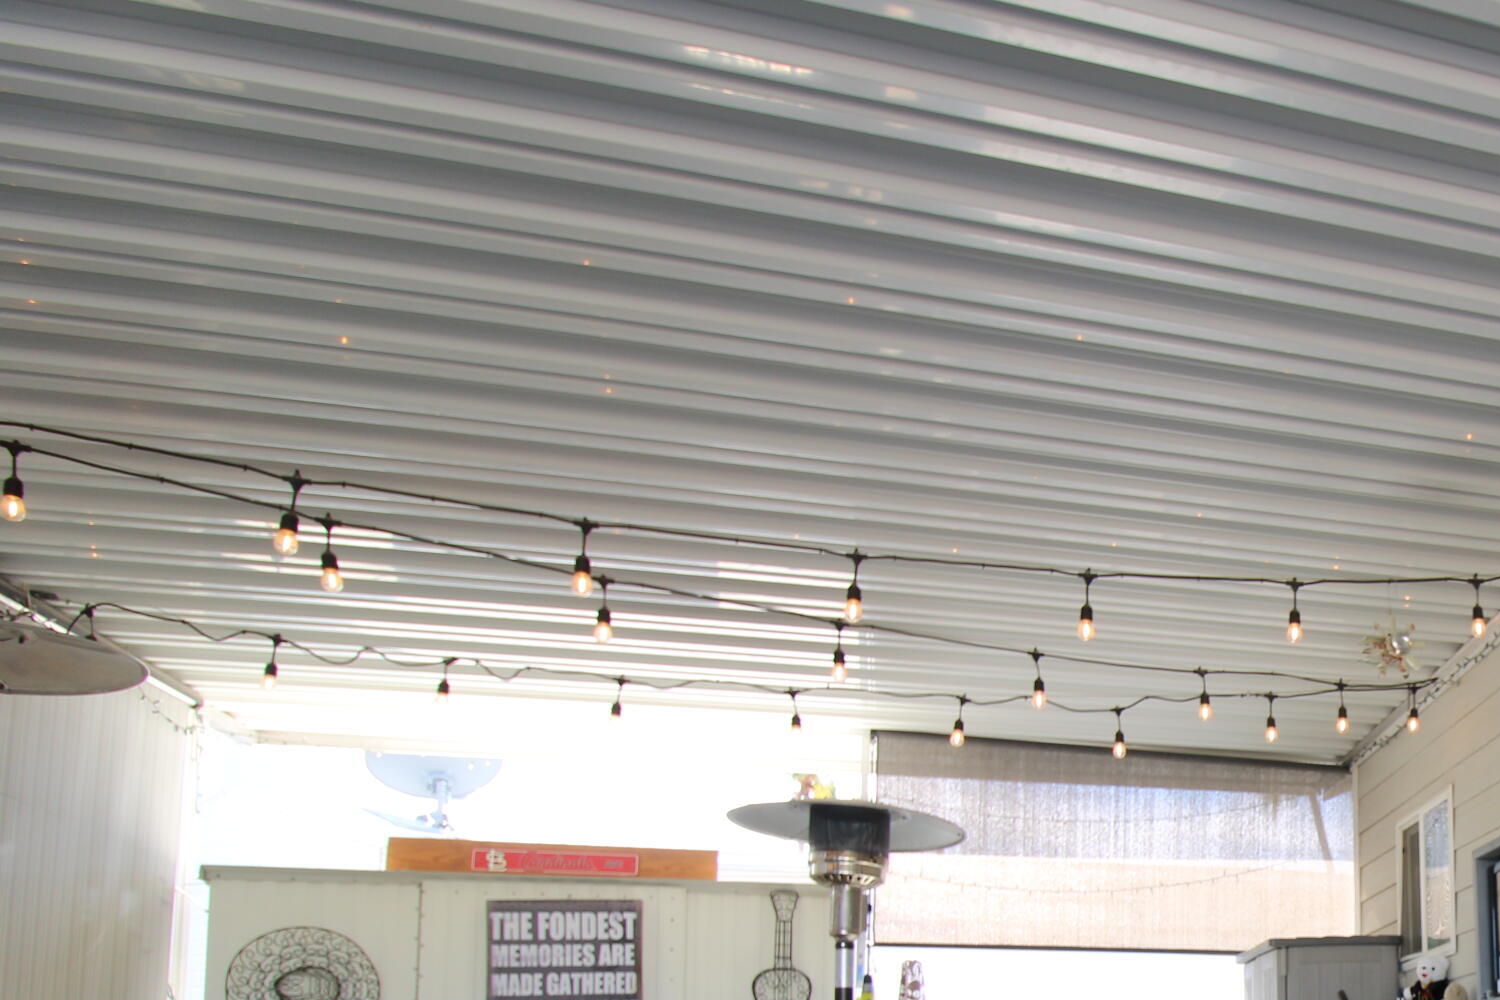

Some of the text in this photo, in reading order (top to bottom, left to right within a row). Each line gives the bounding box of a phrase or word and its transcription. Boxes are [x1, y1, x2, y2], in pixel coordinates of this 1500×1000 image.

[489, 911, 637, 941] THE FONDEST
[491, 943, 635, 968] MEMORIES ARE
[491, 971, 637, 997] MADE GATHERED
